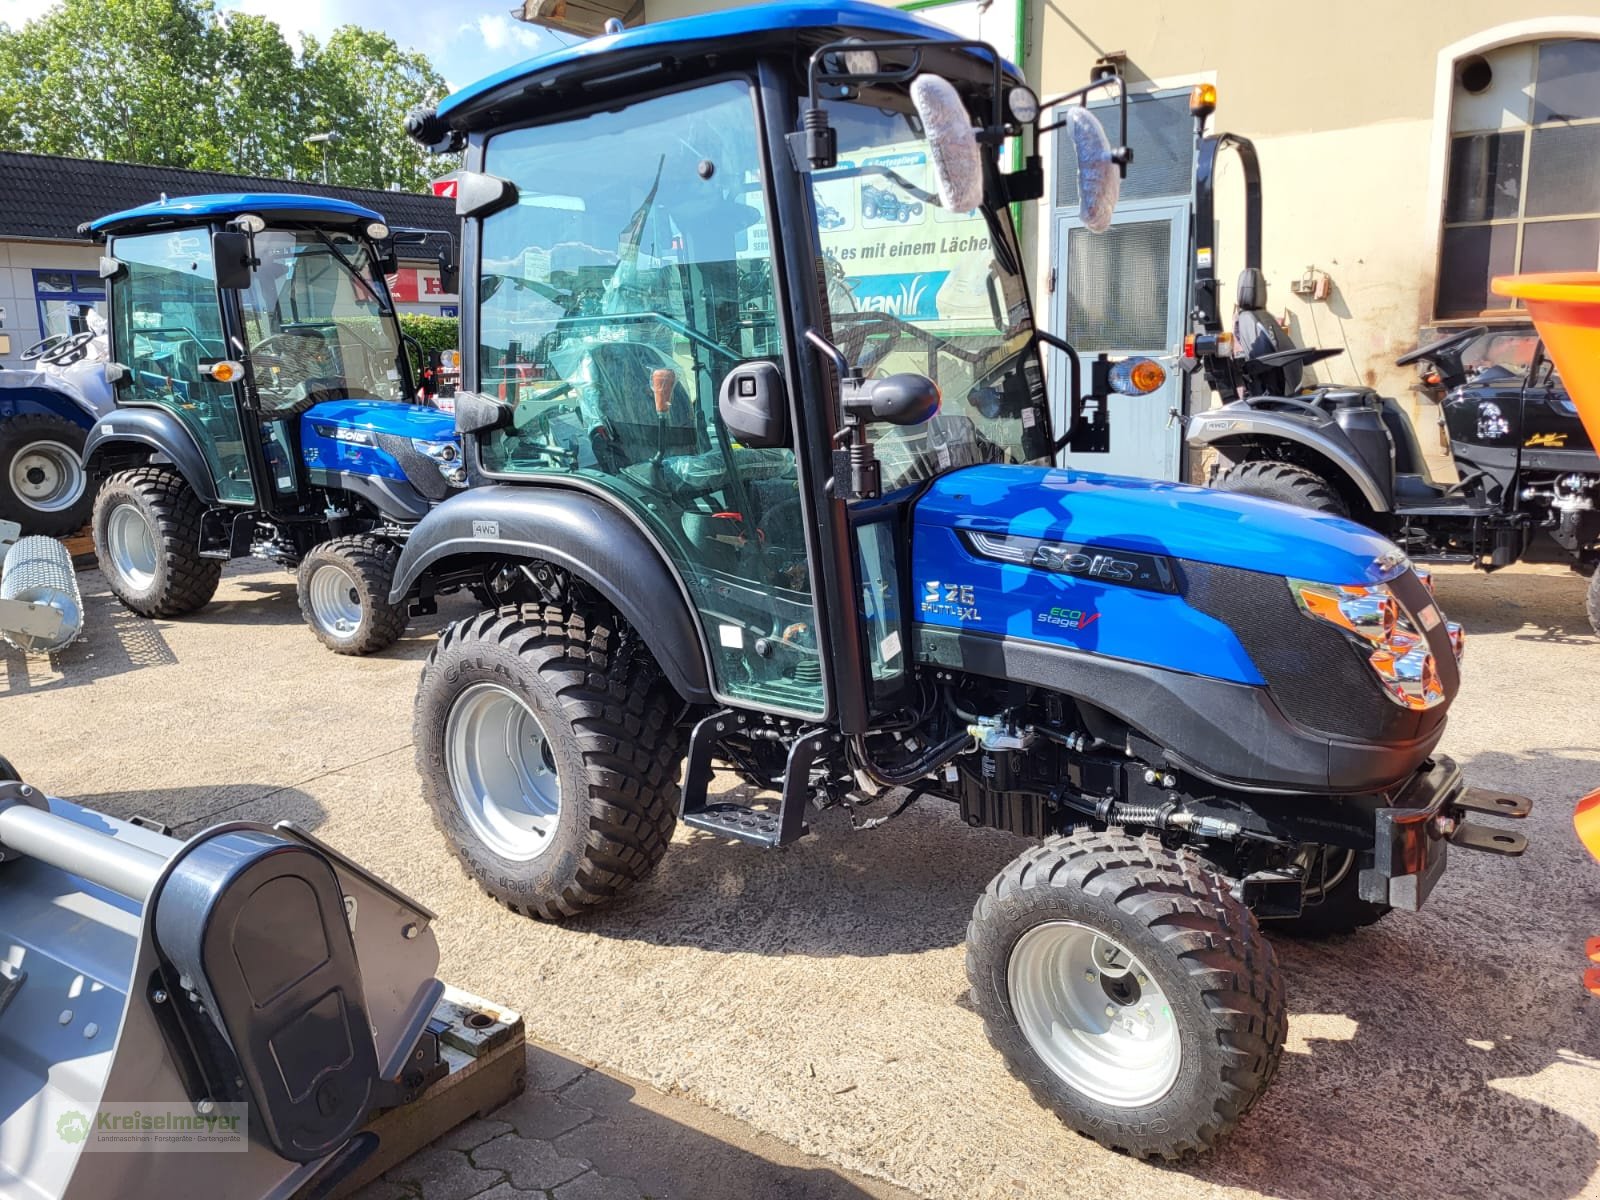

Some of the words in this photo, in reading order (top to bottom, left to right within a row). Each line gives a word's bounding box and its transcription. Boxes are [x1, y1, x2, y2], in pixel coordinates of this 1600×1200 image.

[841, 248, 856, 260] es
[861, 242, 885, 259] mit
[889, 242, 936, 257] einem
[475, 525, 497, 535] 4WD
[1050, 607, 1082, 620] ECO
[1037, 613, 1080, 629] Stage
